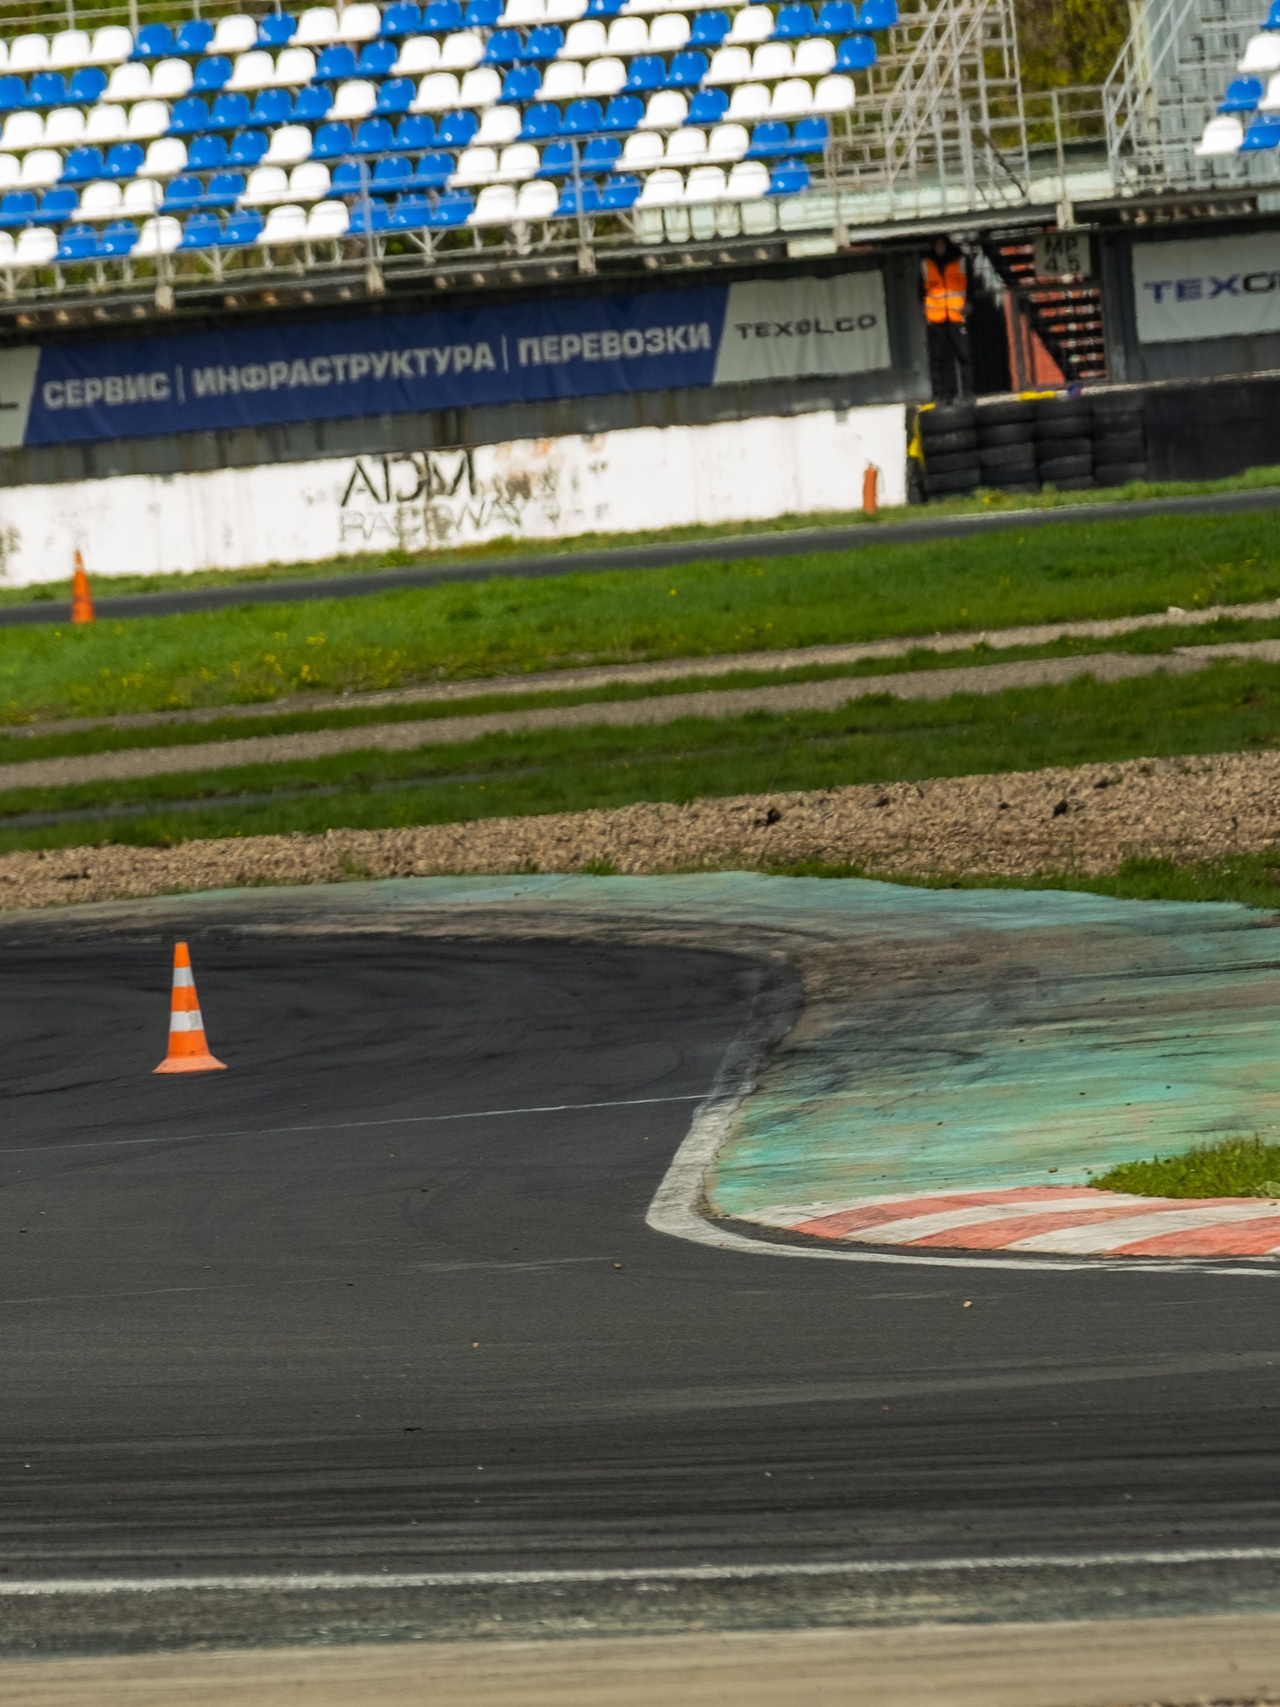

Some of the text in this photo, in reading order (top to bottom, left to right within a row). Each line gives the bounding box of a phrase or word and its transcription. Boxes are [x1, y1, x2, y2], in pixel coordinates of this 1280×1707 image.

[1143, 270, 1280, 304] TEXO
[43, 322, 712, 411] СЕРВИС ИНФРАСТРУКТУРА ПЕРЕВОЗКИ
[341, 450, 476, 507] ADM
